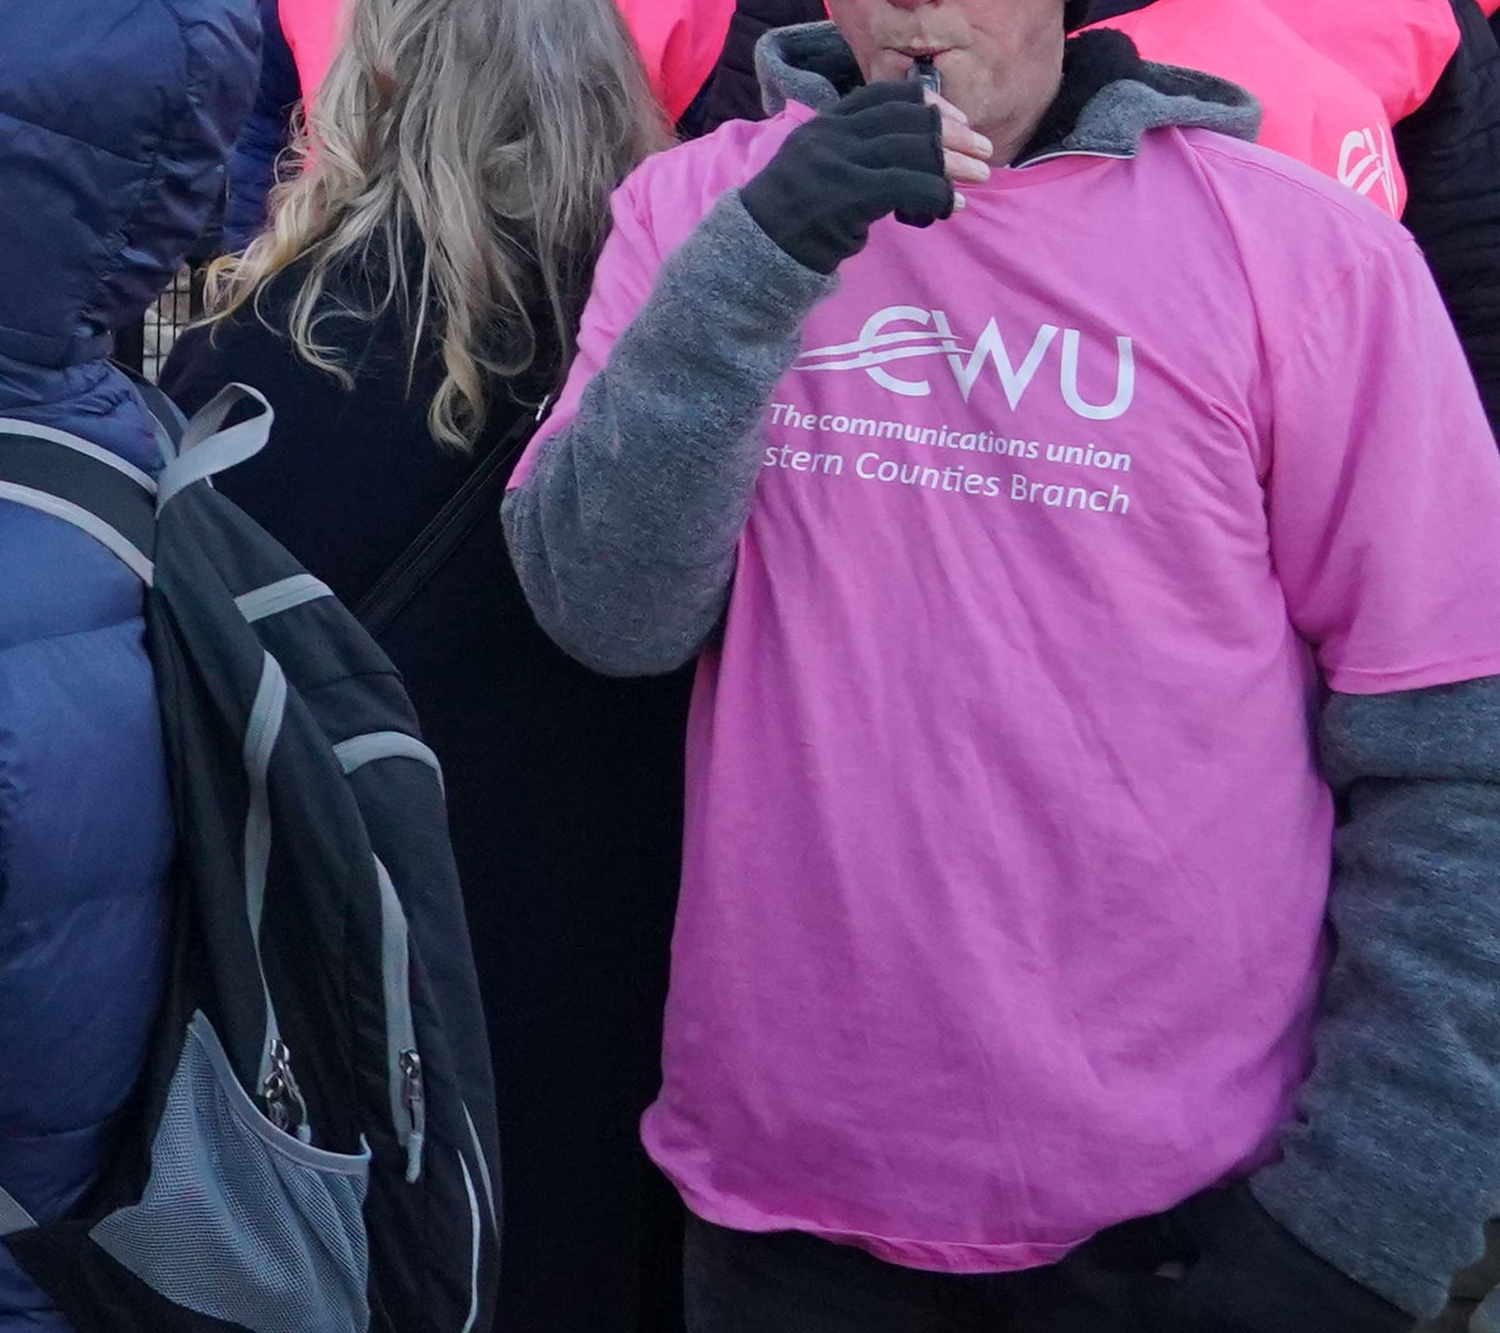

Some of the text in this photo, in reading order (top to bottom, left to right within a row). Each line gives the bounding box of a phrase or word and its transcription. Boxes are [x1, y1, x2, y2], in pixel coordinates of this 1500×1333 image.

[850, 305, 1136, 421] CWU
[763, 444, 1132, 515] stern Counties Branch
[1045, 444, 1134, 474] union
